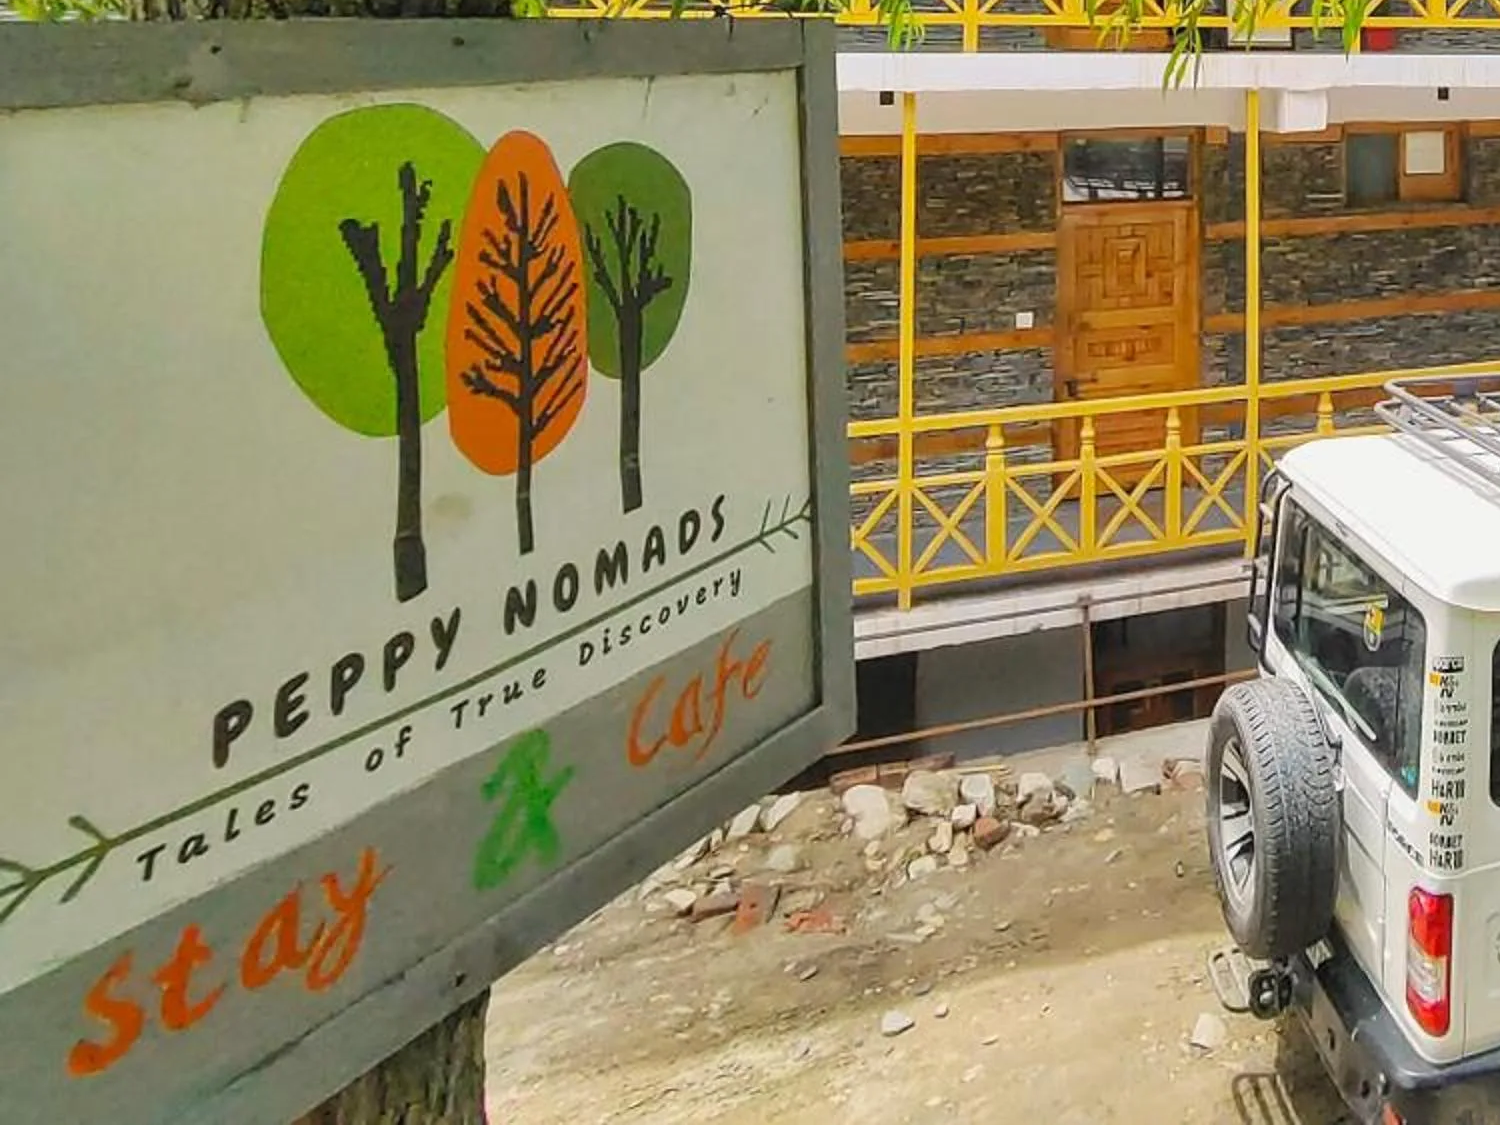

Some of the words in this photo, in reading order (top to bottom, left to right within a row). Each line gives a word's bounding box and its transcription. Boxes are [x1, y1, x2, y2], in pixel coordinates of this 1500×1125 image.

[136, 782, 311, 882] Tales
[365, 726, 413, 773] of
[450, 667, 547, 729] True
[577, 568, 744, 667] Discovery
[212, 607, 463, 767] PEPPY
[503, 493, 729, 635] NOMADS
[625, 626, 777, 768] Cafe
